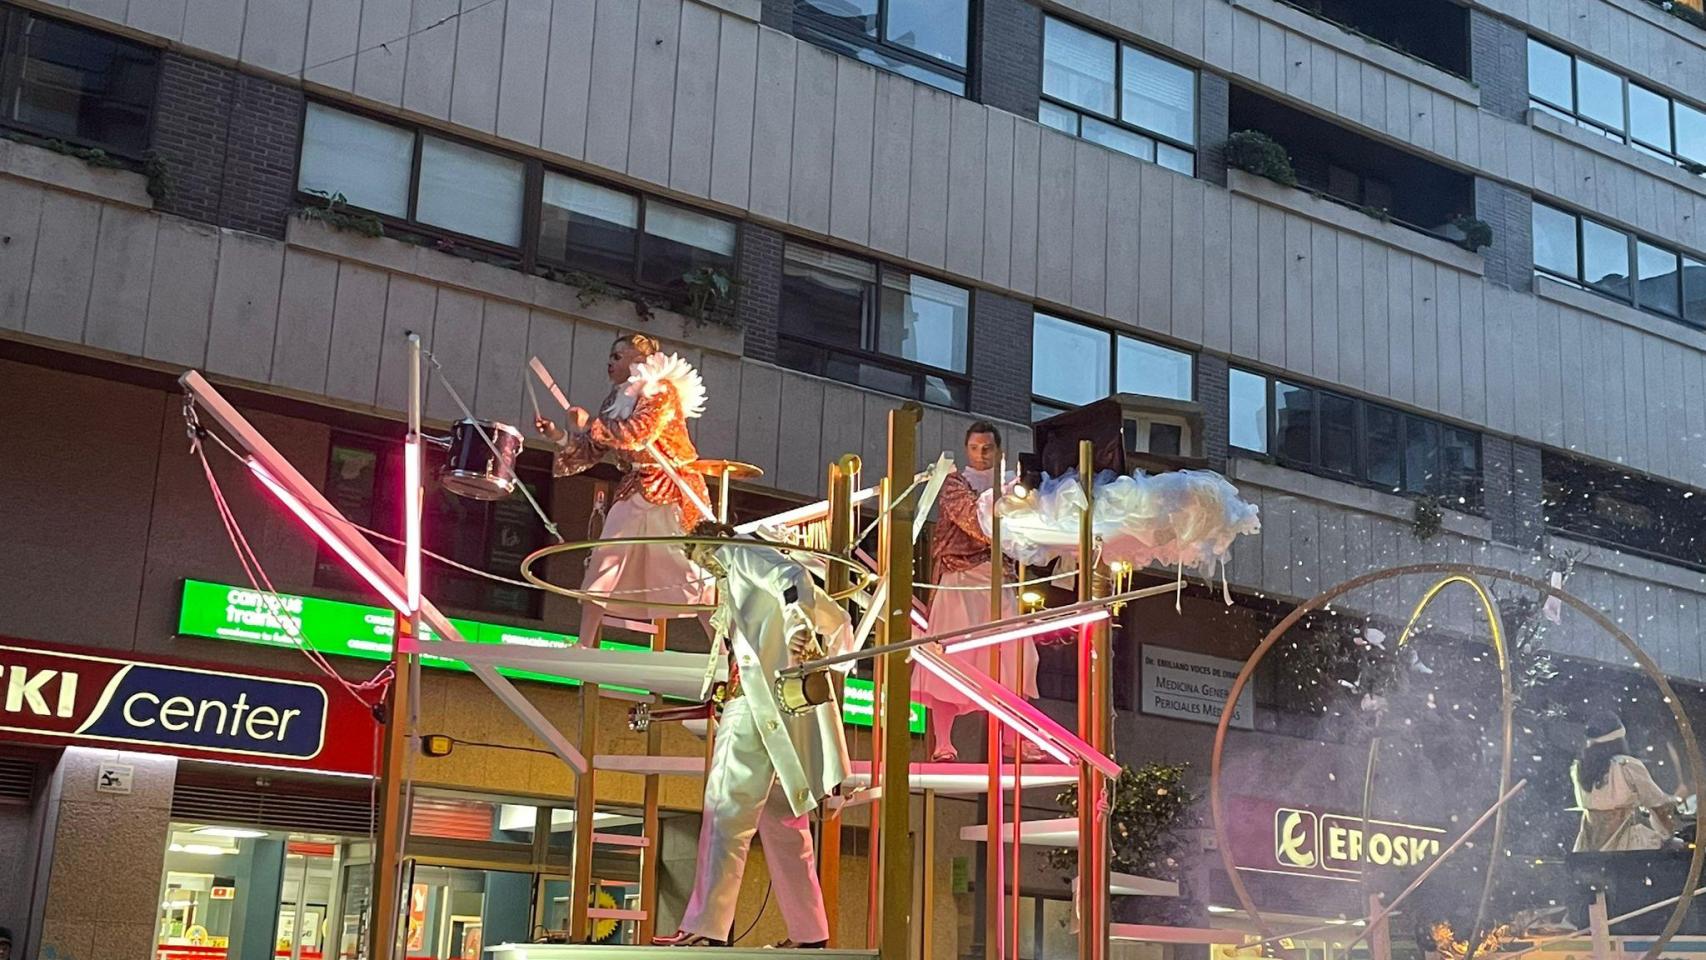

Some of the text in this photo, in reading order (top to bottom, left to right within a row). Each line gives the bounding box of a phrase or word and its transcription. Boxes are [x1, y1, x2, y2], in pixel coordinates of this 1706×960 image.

[0, 664, 301, 742] KI center
[1156, 676, 1229, 699] MEDICINA GENER
[1155, 696, 1200, 713] PERICIALES
[1328, 826, 1440, 867] EROSKI
